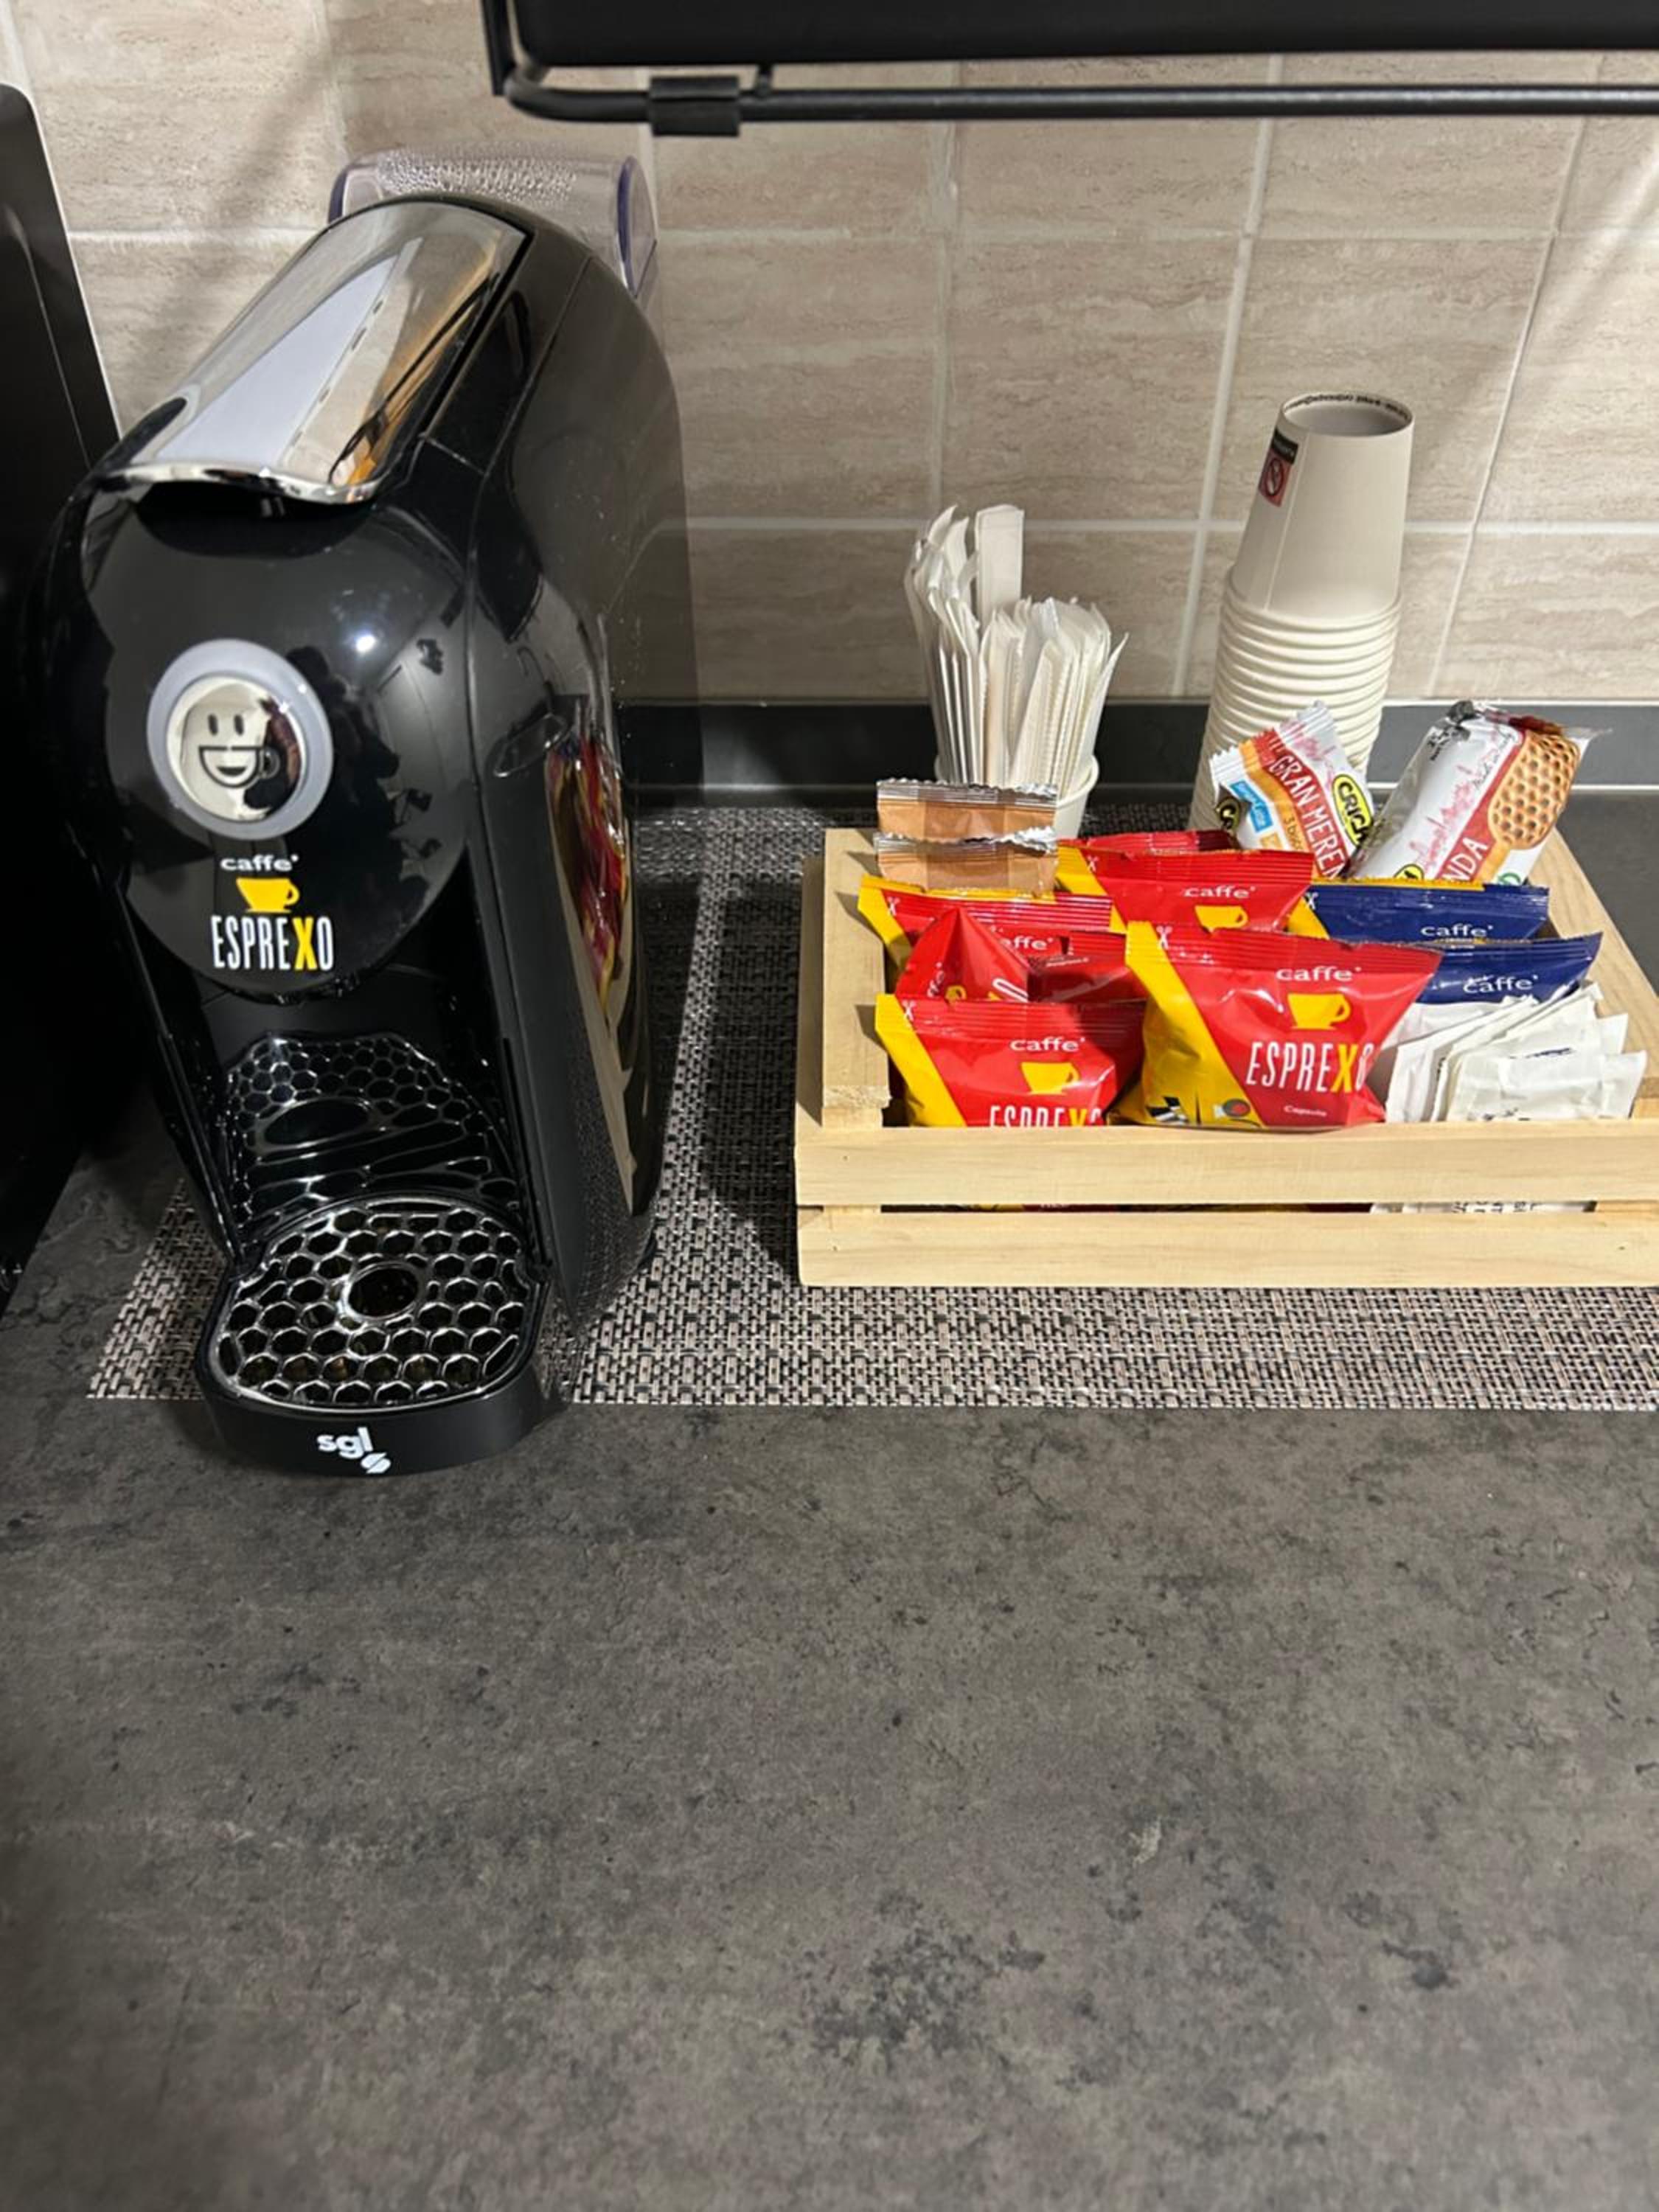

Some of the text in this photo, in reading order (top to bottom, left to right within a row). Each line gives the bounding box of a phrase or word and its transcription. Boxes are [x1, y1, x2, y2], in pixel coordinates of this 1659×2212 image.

[1271, 755, 1320, 807] GRAN
[1301, 805, 1346, 880] MEREN
[211, 914, 334, 971] ESPREXO
[316, 1426, 374, 1459] sgl
